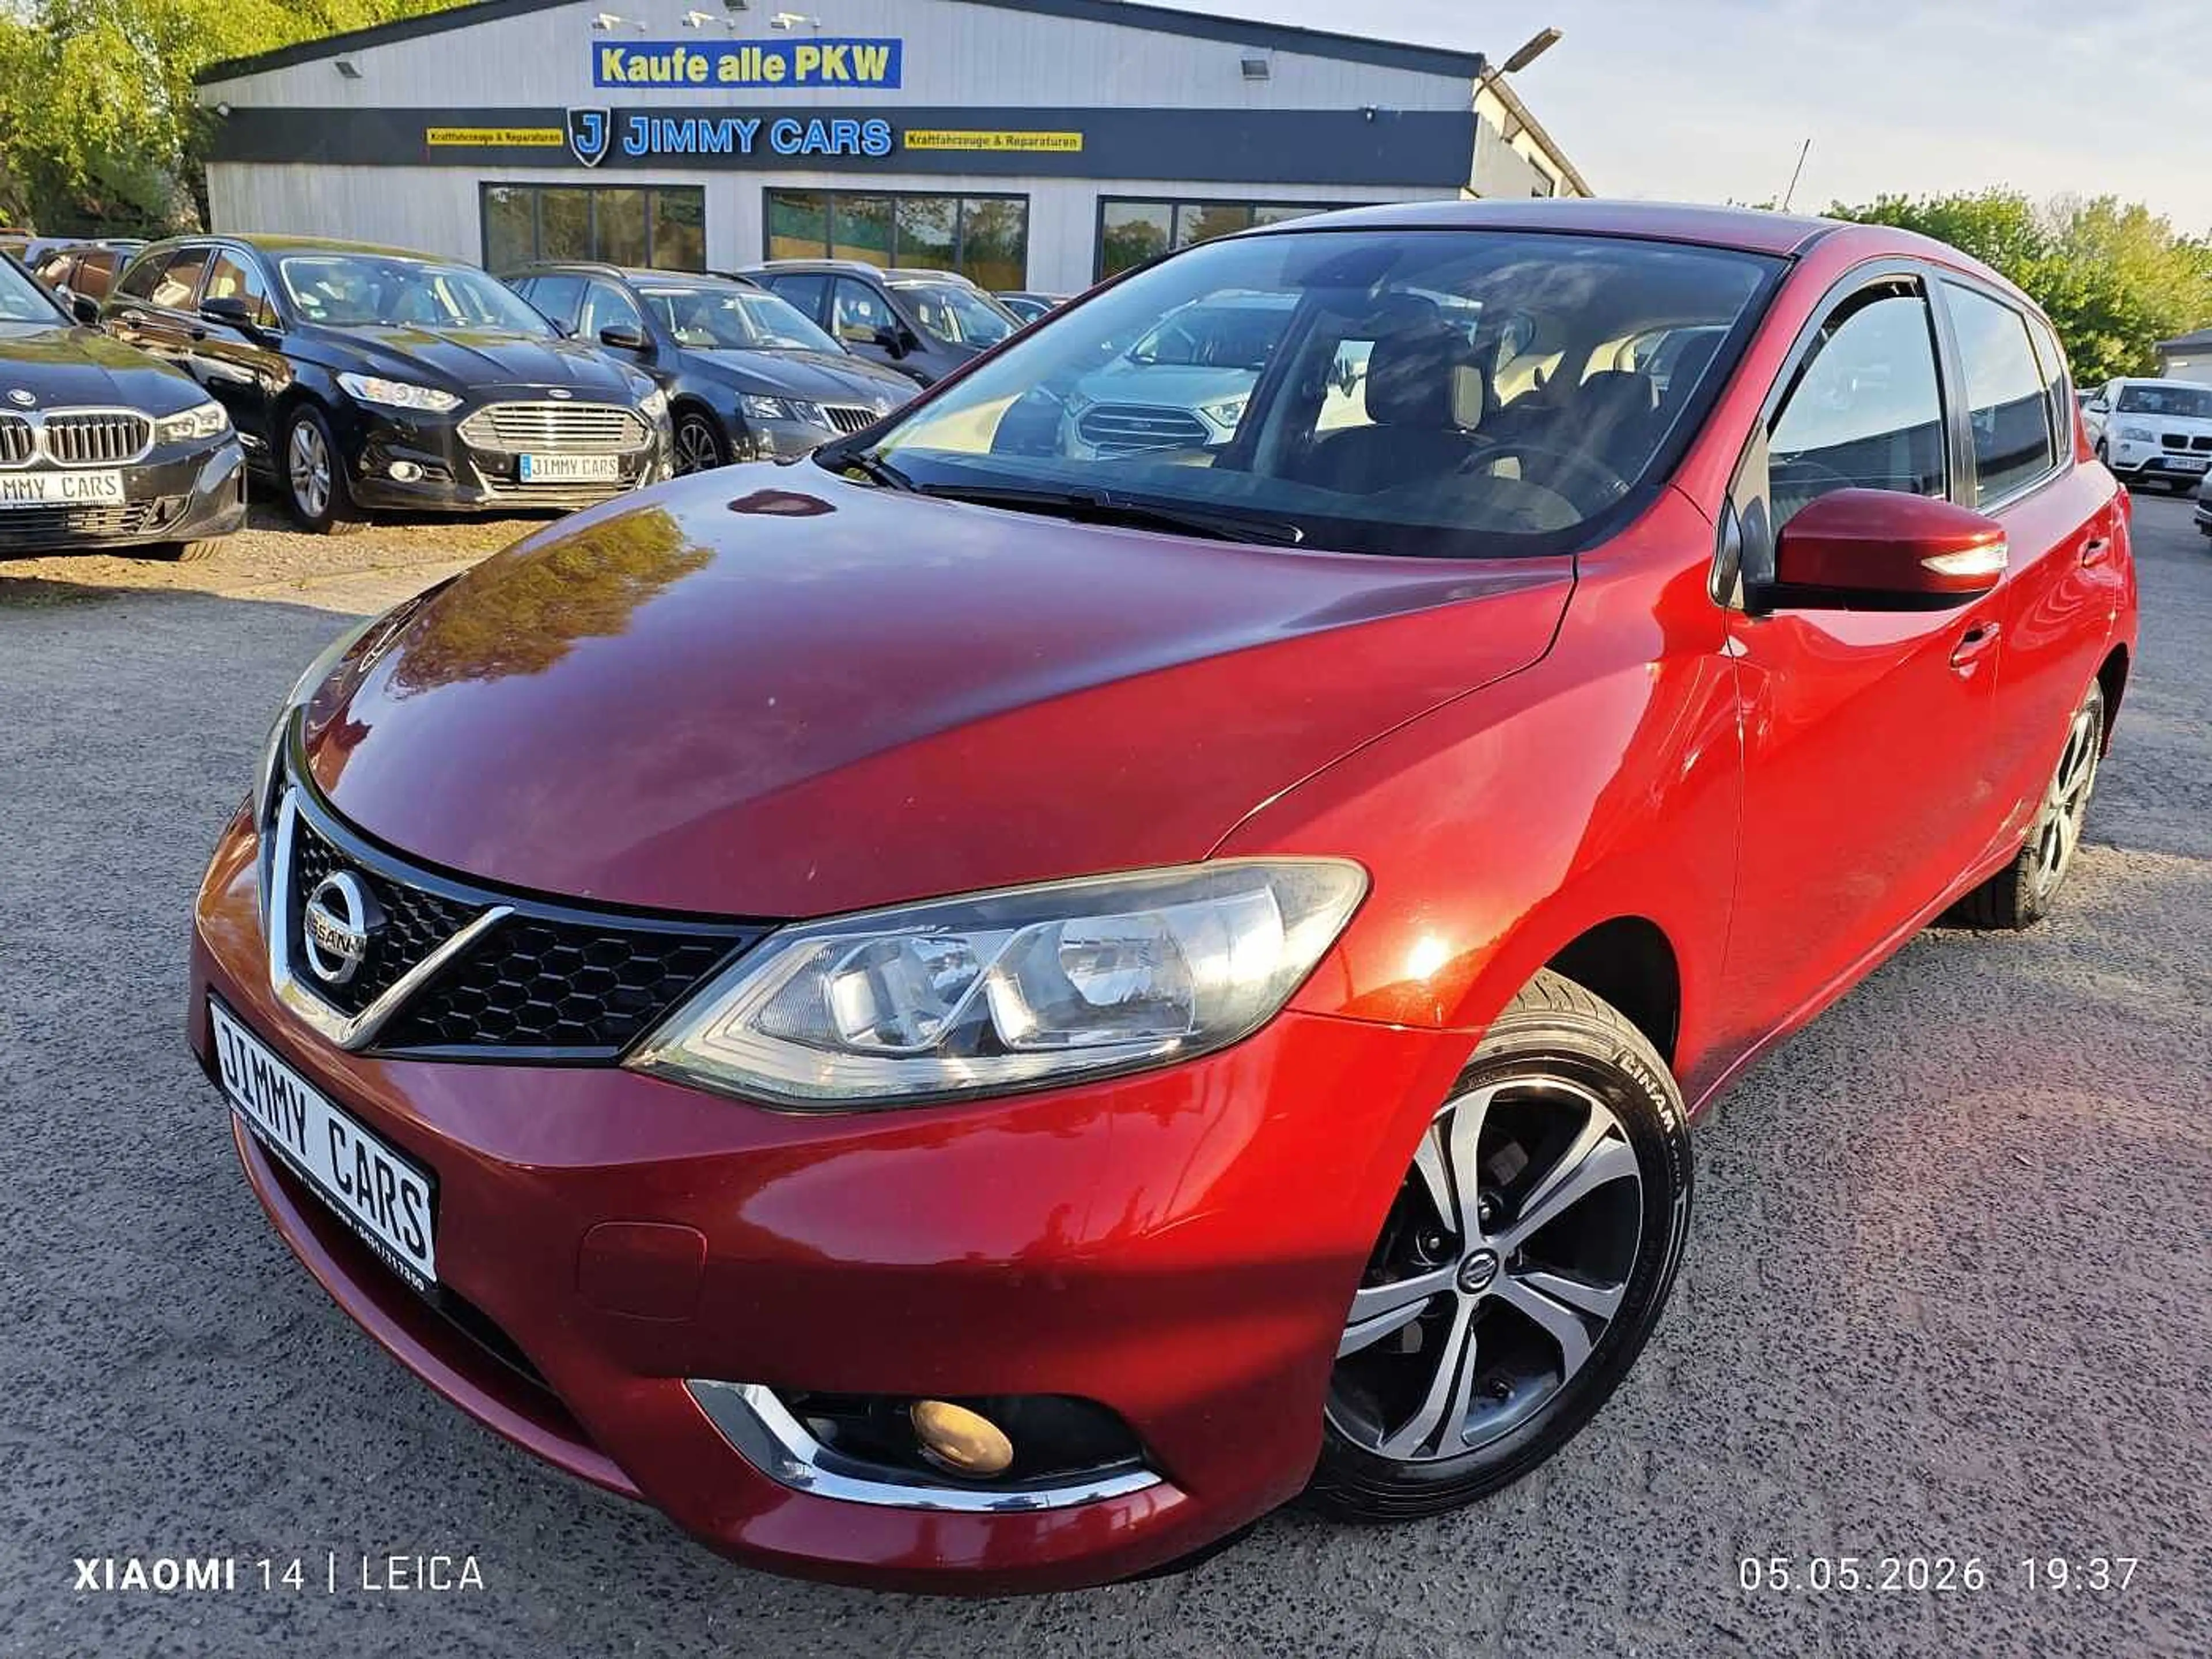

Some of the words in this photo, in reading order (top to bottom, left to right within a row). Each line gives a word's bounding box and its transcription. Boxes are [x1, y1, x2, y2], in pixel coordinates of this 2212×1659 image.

[601, 48, 709, 82] Kaufe
[718, 47, 786, 82] alle
[795, 45, 889, 81] PKW
[624, 117, 762, 155] JIMMY
[771, 118, 891, 156] CARS
[907, 132, 991, 148] Kraftfahrzeuge
[994, 135, 1002, 146] &
[1006, 135, 1077, 149] Reparaturen
[533, 458, 576, 475] JIMMY
[62, 475, 116, 498] CARS
[221, 1022, 306, 1155] JIMMY
[329, 1118, 426, 1259] CARS
